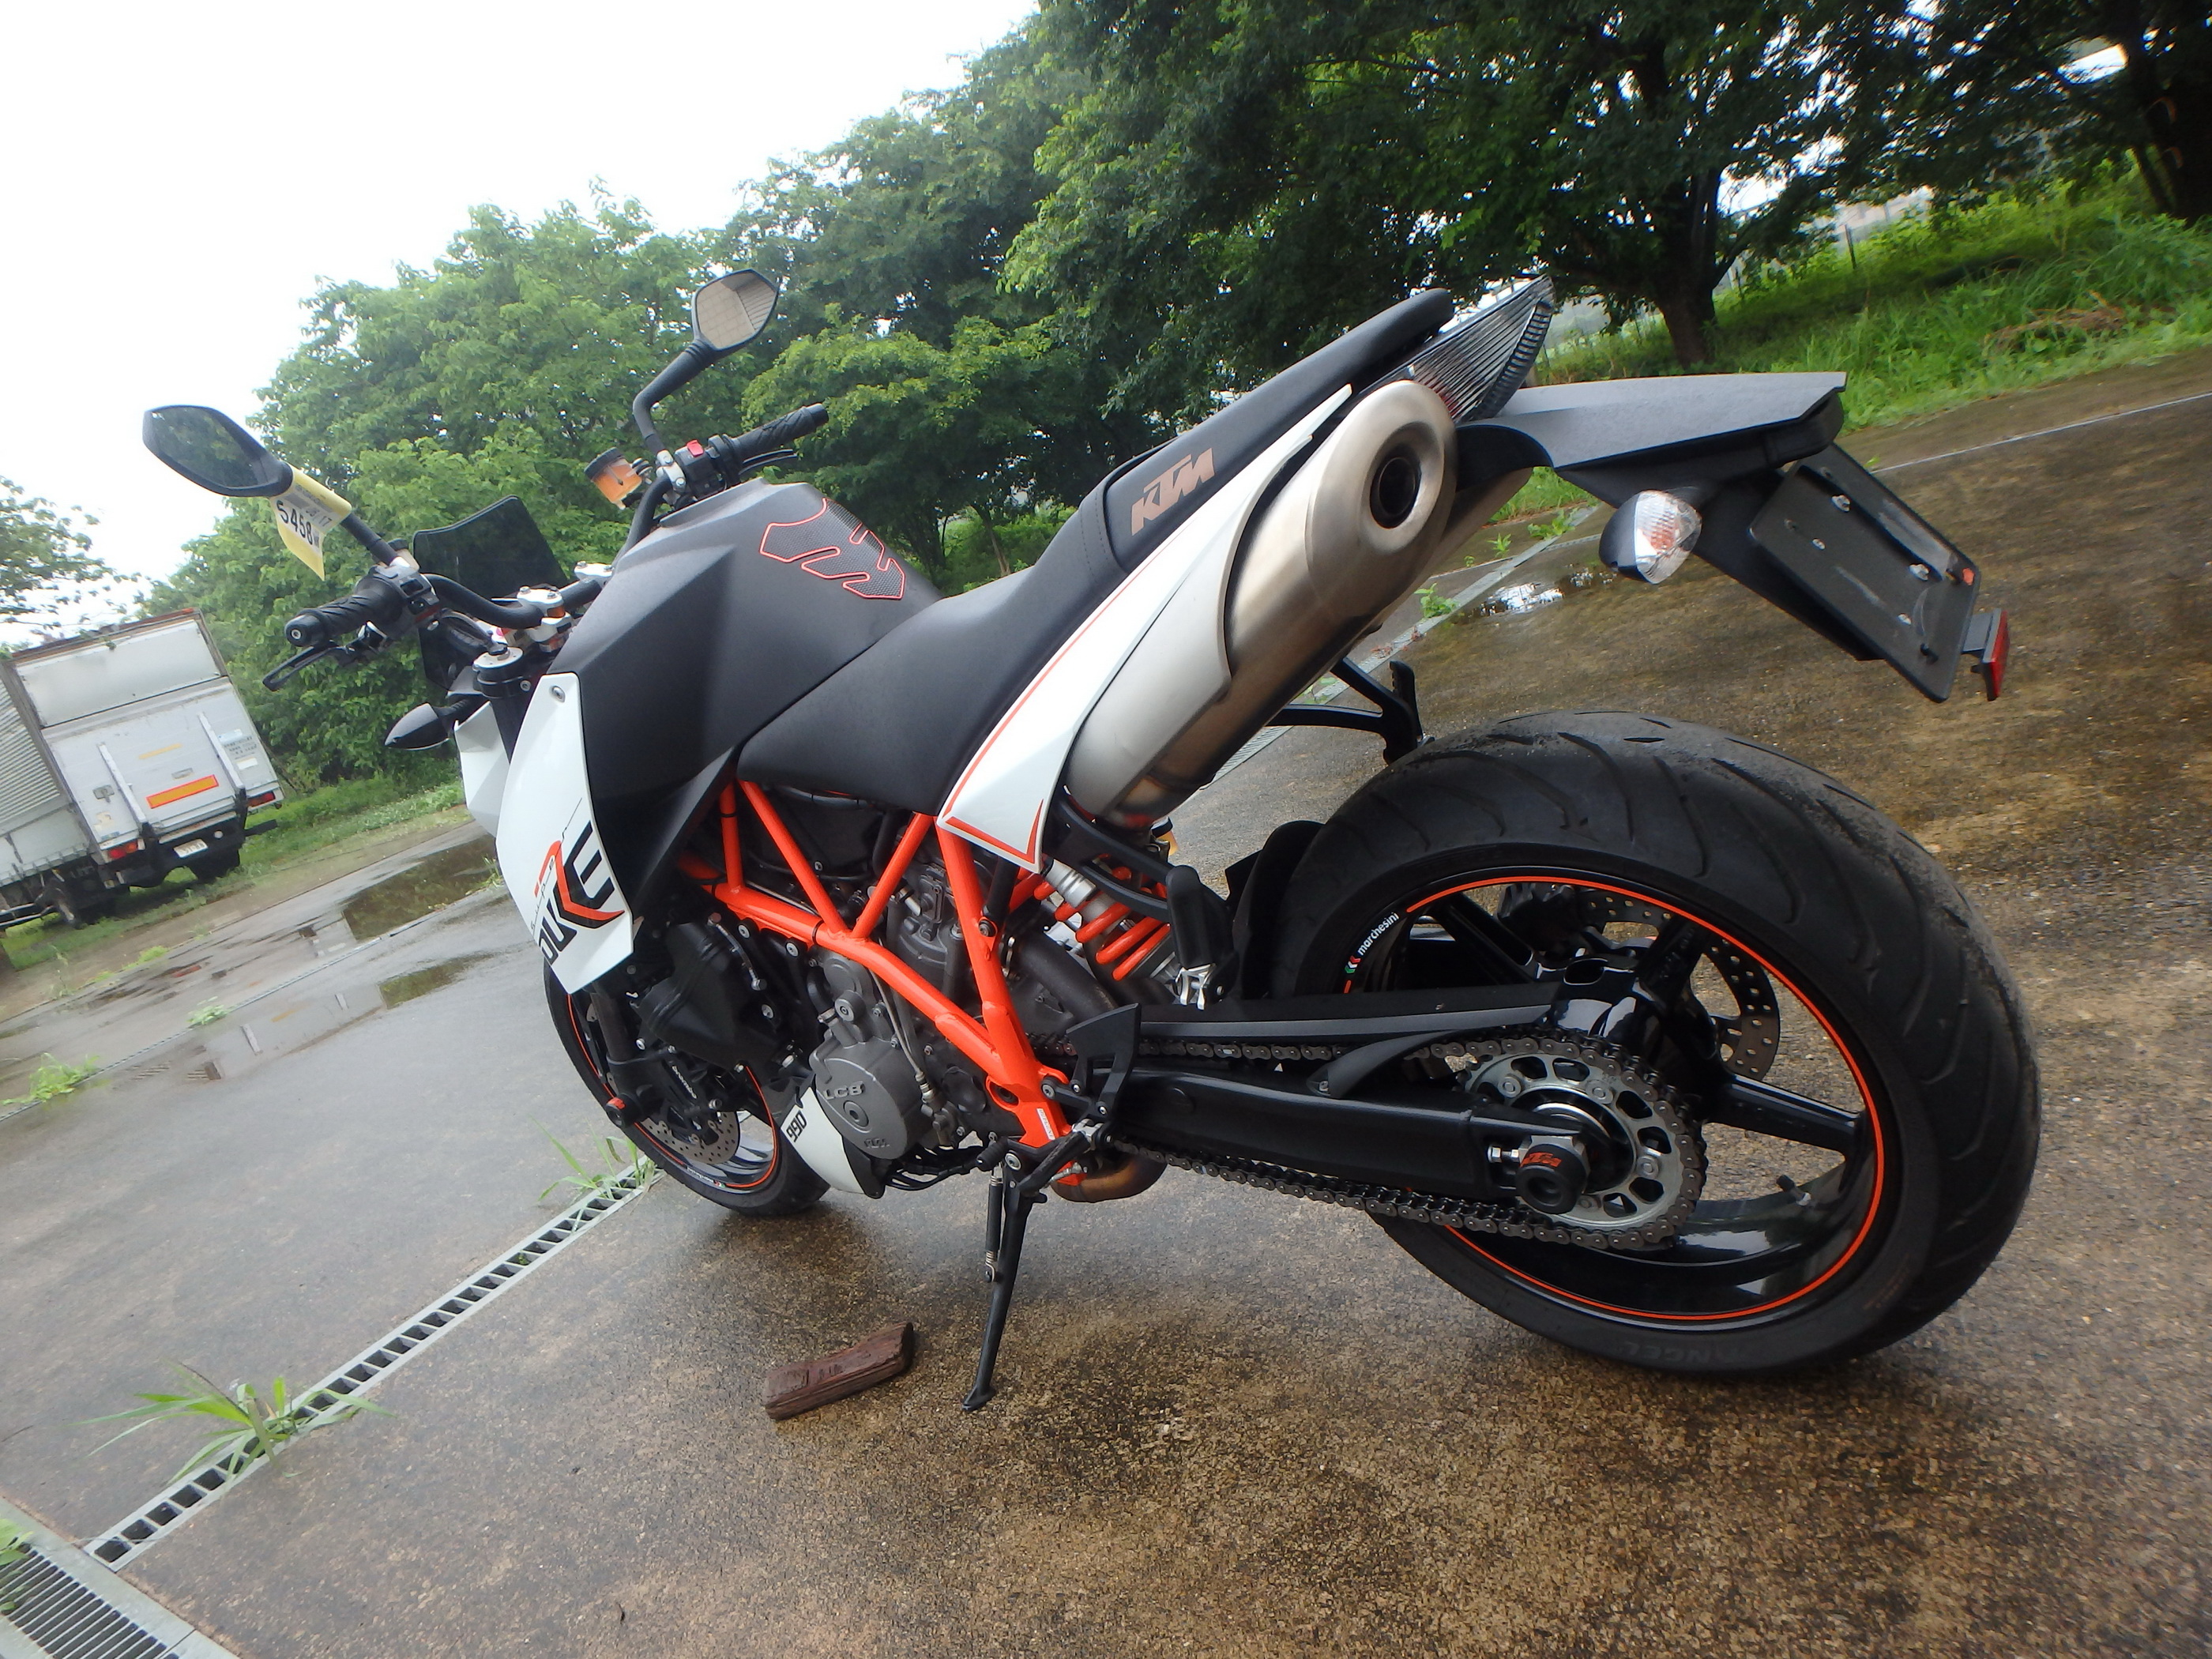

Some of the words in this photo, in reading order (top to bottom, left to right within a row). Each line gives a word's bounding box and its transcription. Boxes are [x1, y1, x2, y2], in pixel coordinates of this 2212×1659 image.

[1130, 447, 1215, 536] KTM
[1357, 912, 1400, 956] marchesini
[785, 1109, 807, 1143] 990
